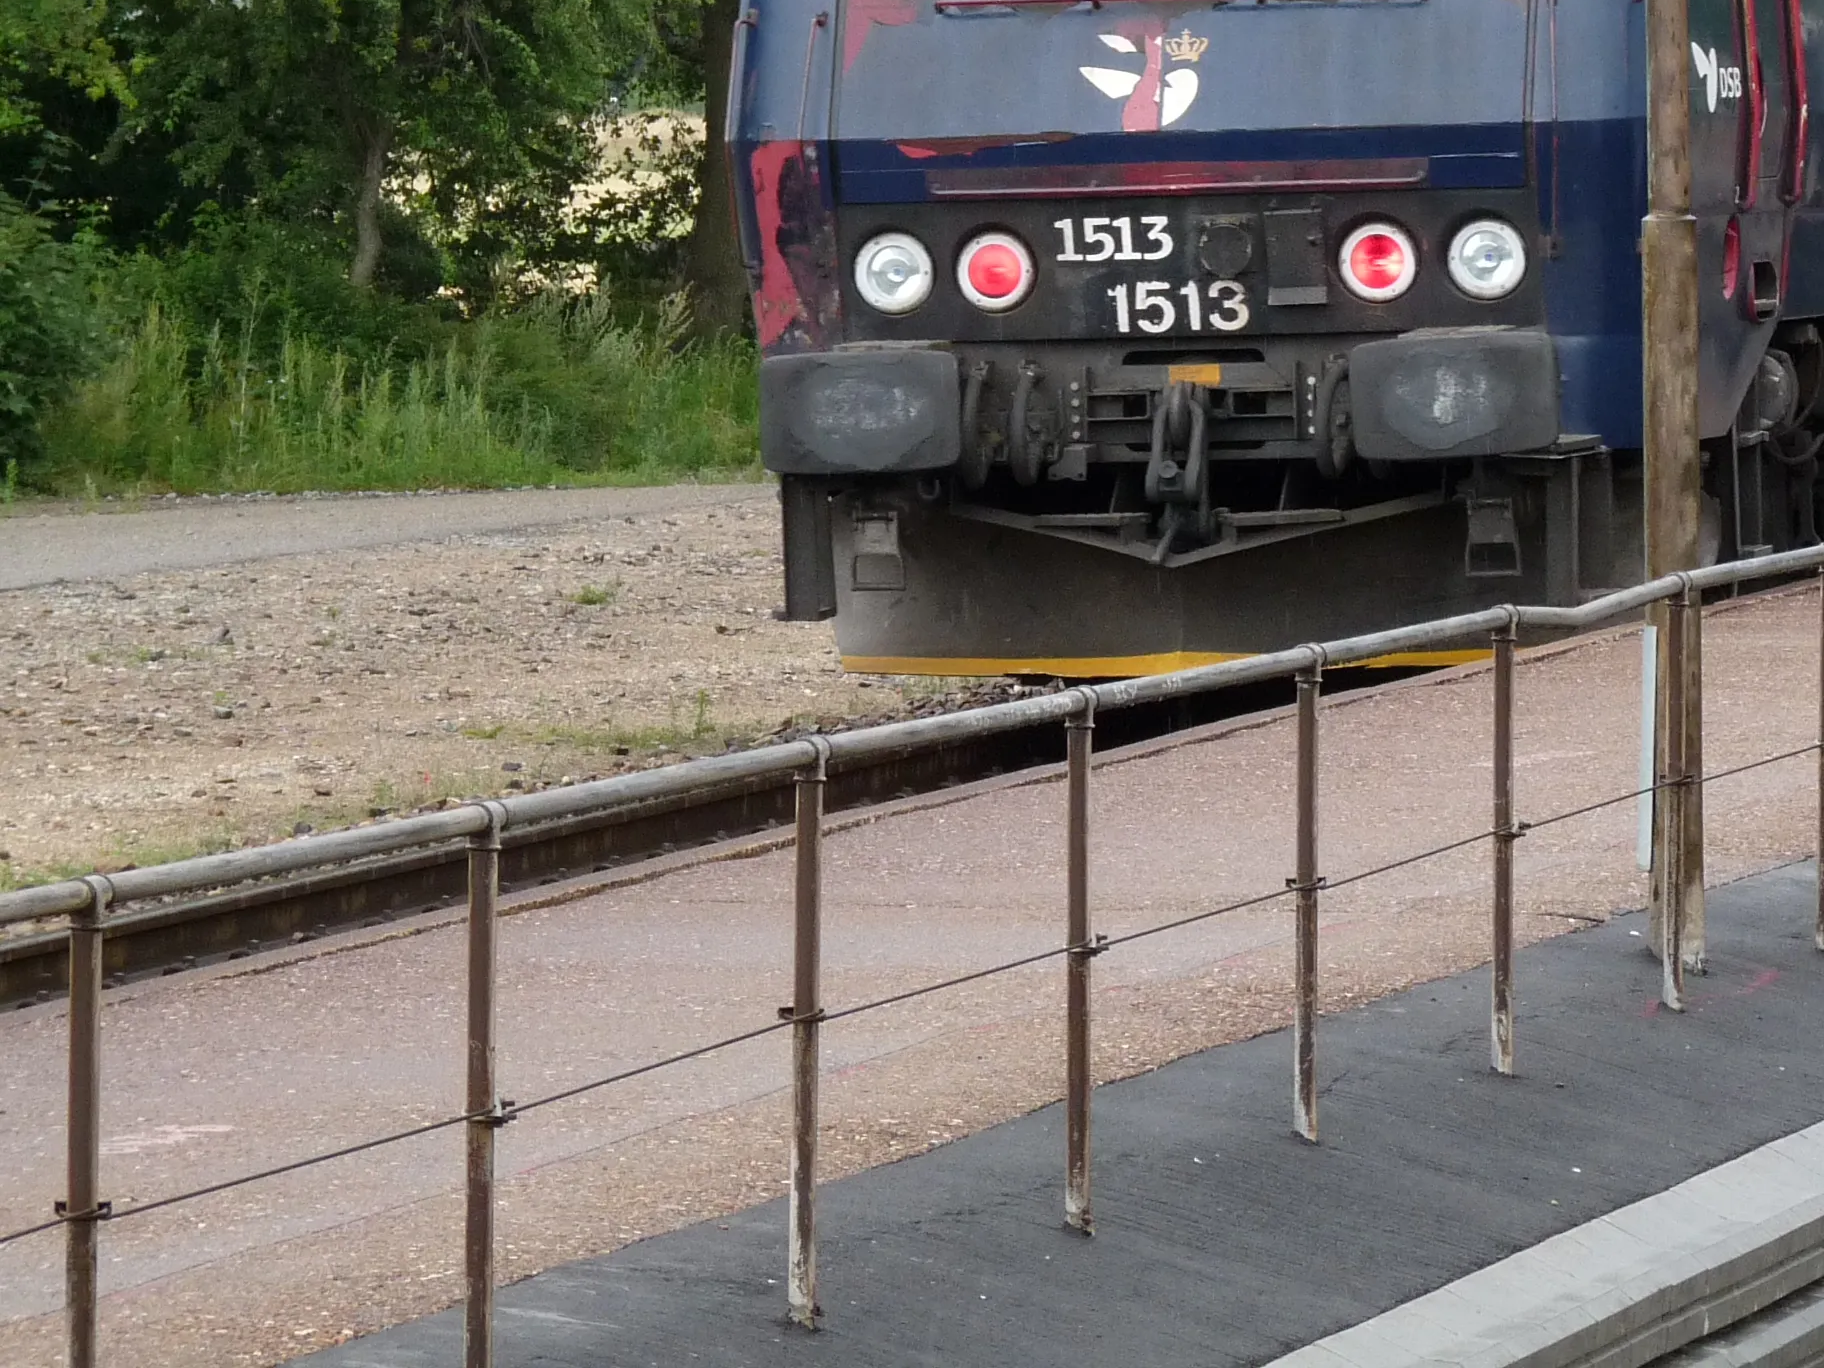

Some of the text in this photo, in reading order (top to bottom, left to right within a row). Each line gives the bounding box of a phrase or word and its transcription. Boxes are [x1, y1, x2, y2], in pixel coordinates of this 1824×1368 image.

[1719, 67, 1742, 98] DSB
[1053, 216, 1174, 262] 1513
[1107, 280, 1250, 333] 1513
